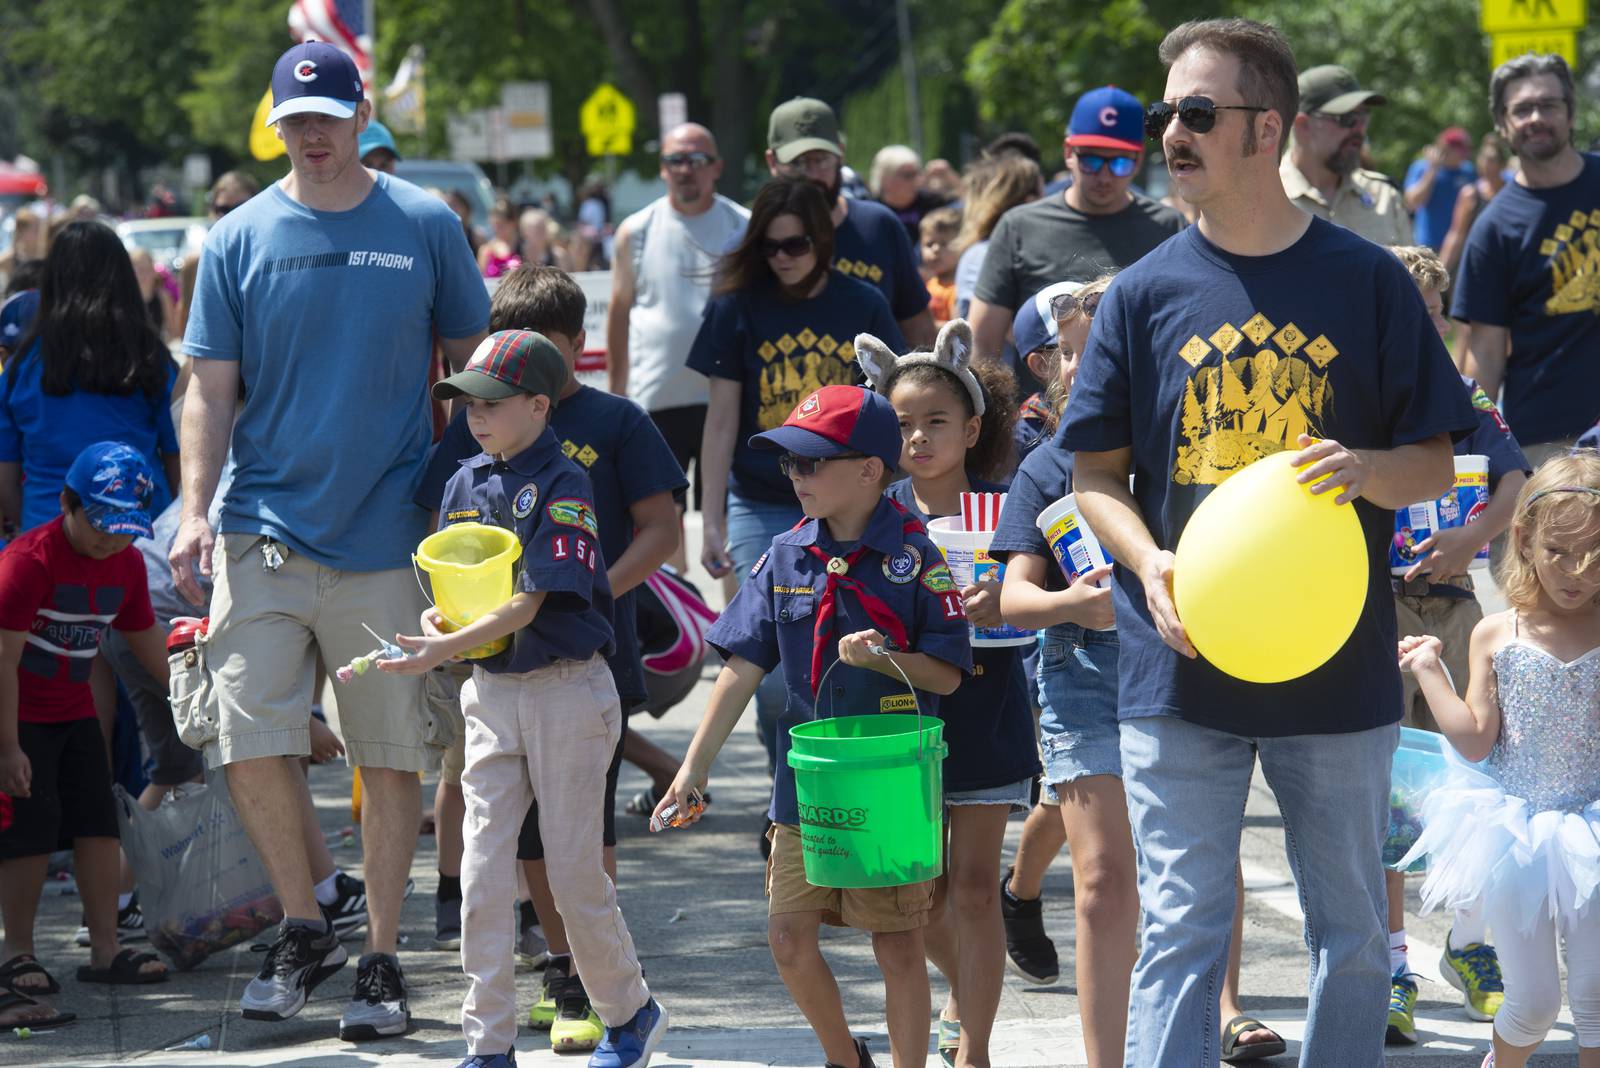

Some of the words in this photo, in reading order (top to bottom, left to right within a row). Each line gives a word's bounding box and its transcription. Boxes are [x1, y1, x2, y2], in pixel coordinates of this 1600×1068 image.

[294, 60, 318, 83] C
[1100, 106, 1119, 127] C
[348, 251, 369, 266] 1ST
[368, 251, 414, 271] PHORM
[891, 699, 908, 708] LION
[161, 825, 205, 859] Walmart
[827, 836, 836, 845] to
